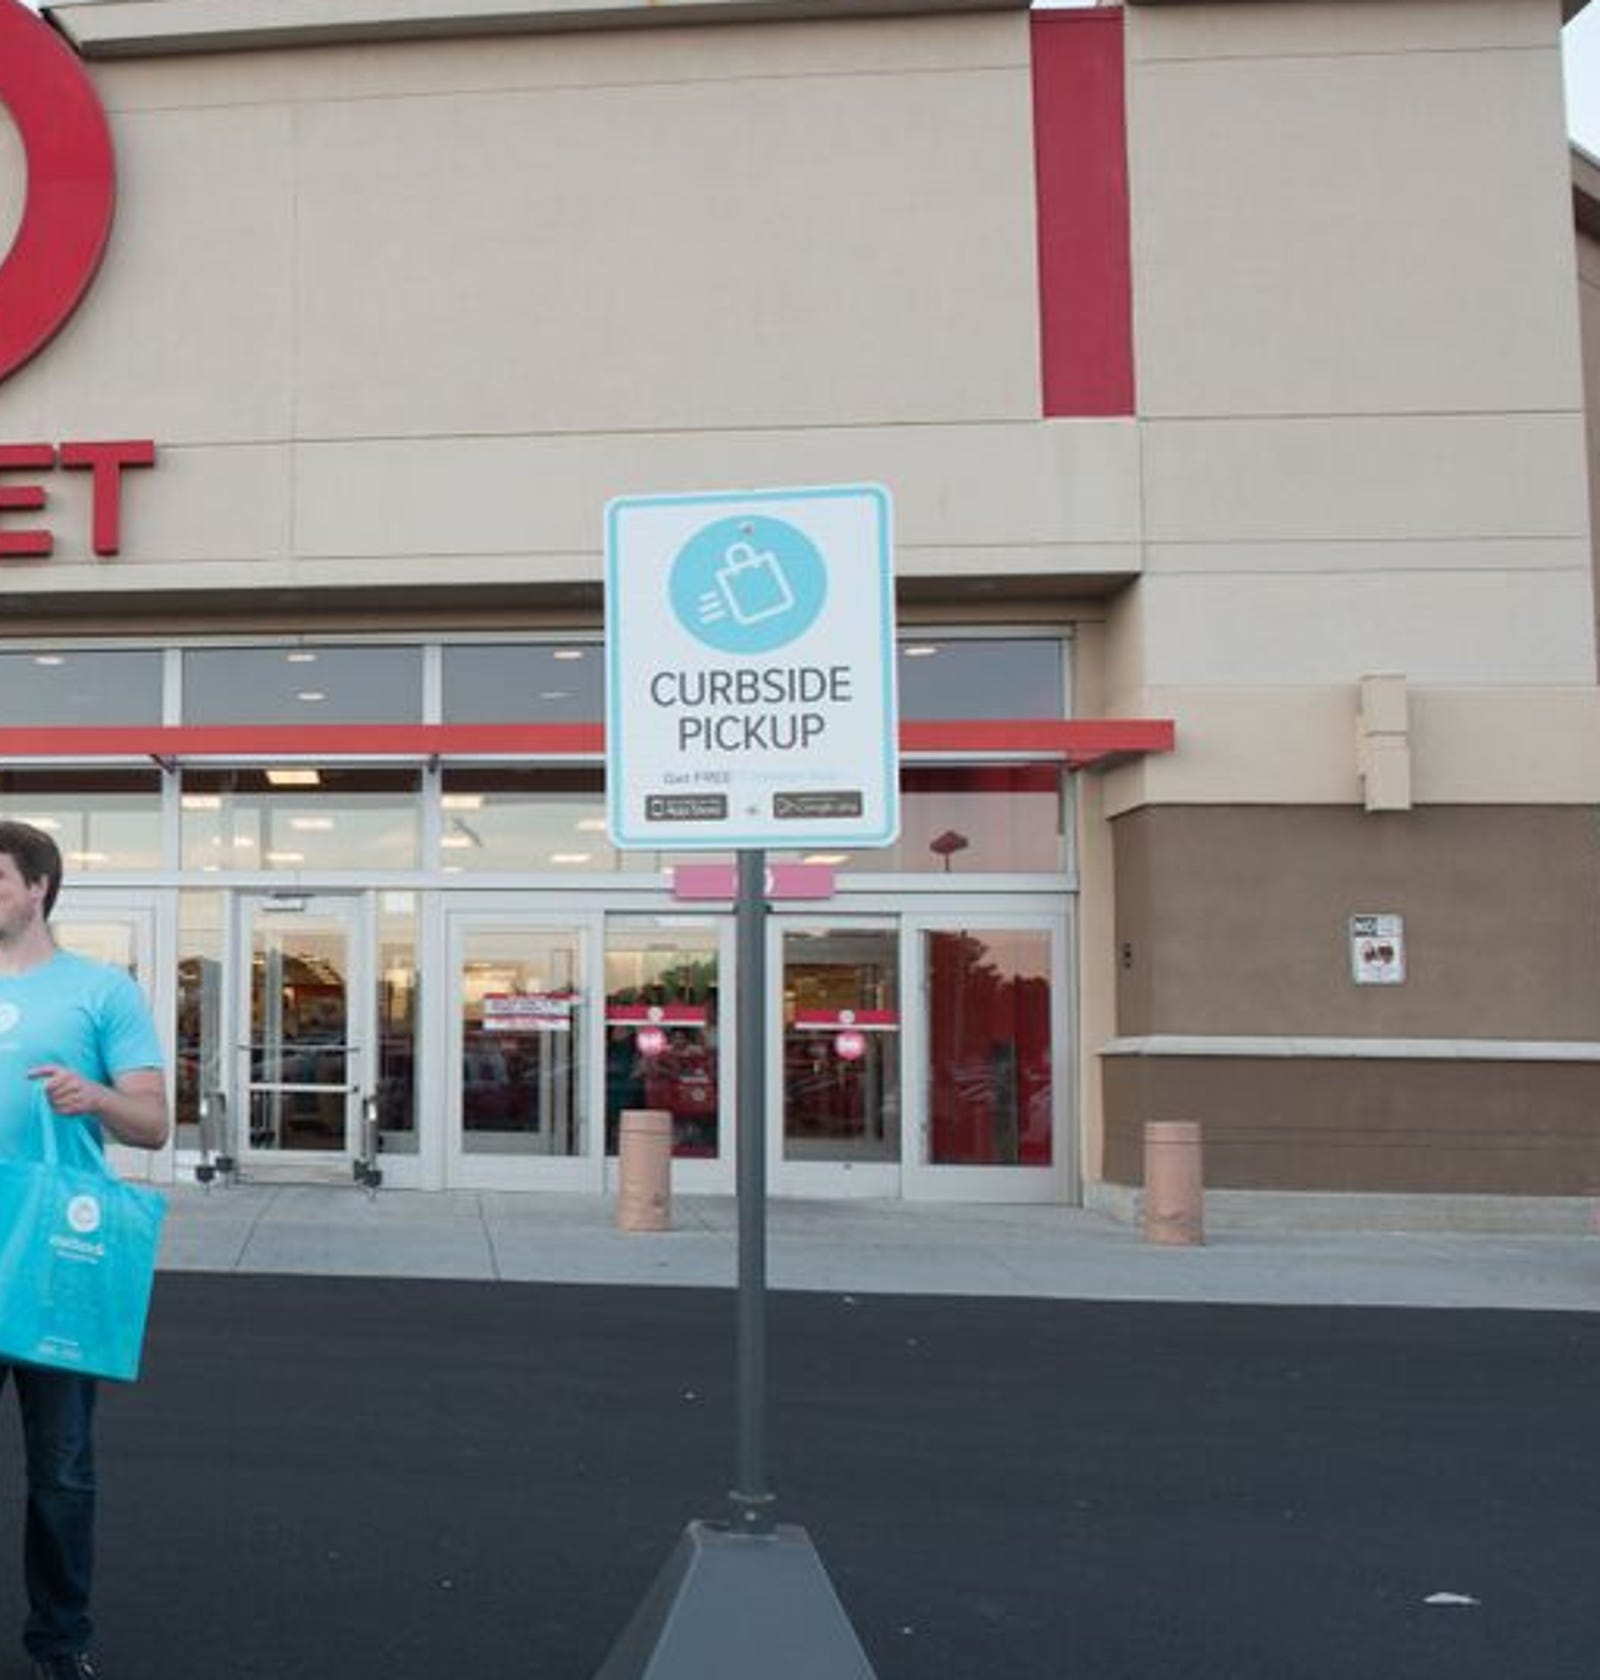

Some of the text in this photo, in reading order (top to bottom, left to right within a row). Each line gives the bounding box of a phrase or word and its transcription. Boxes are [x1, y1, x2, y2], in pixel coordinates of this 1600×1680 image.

[650, 666, 853, 708] CURBSIDE
[678, 712, 826, 751] PICKUP
[663, 771, 732, 785] Get FREE
